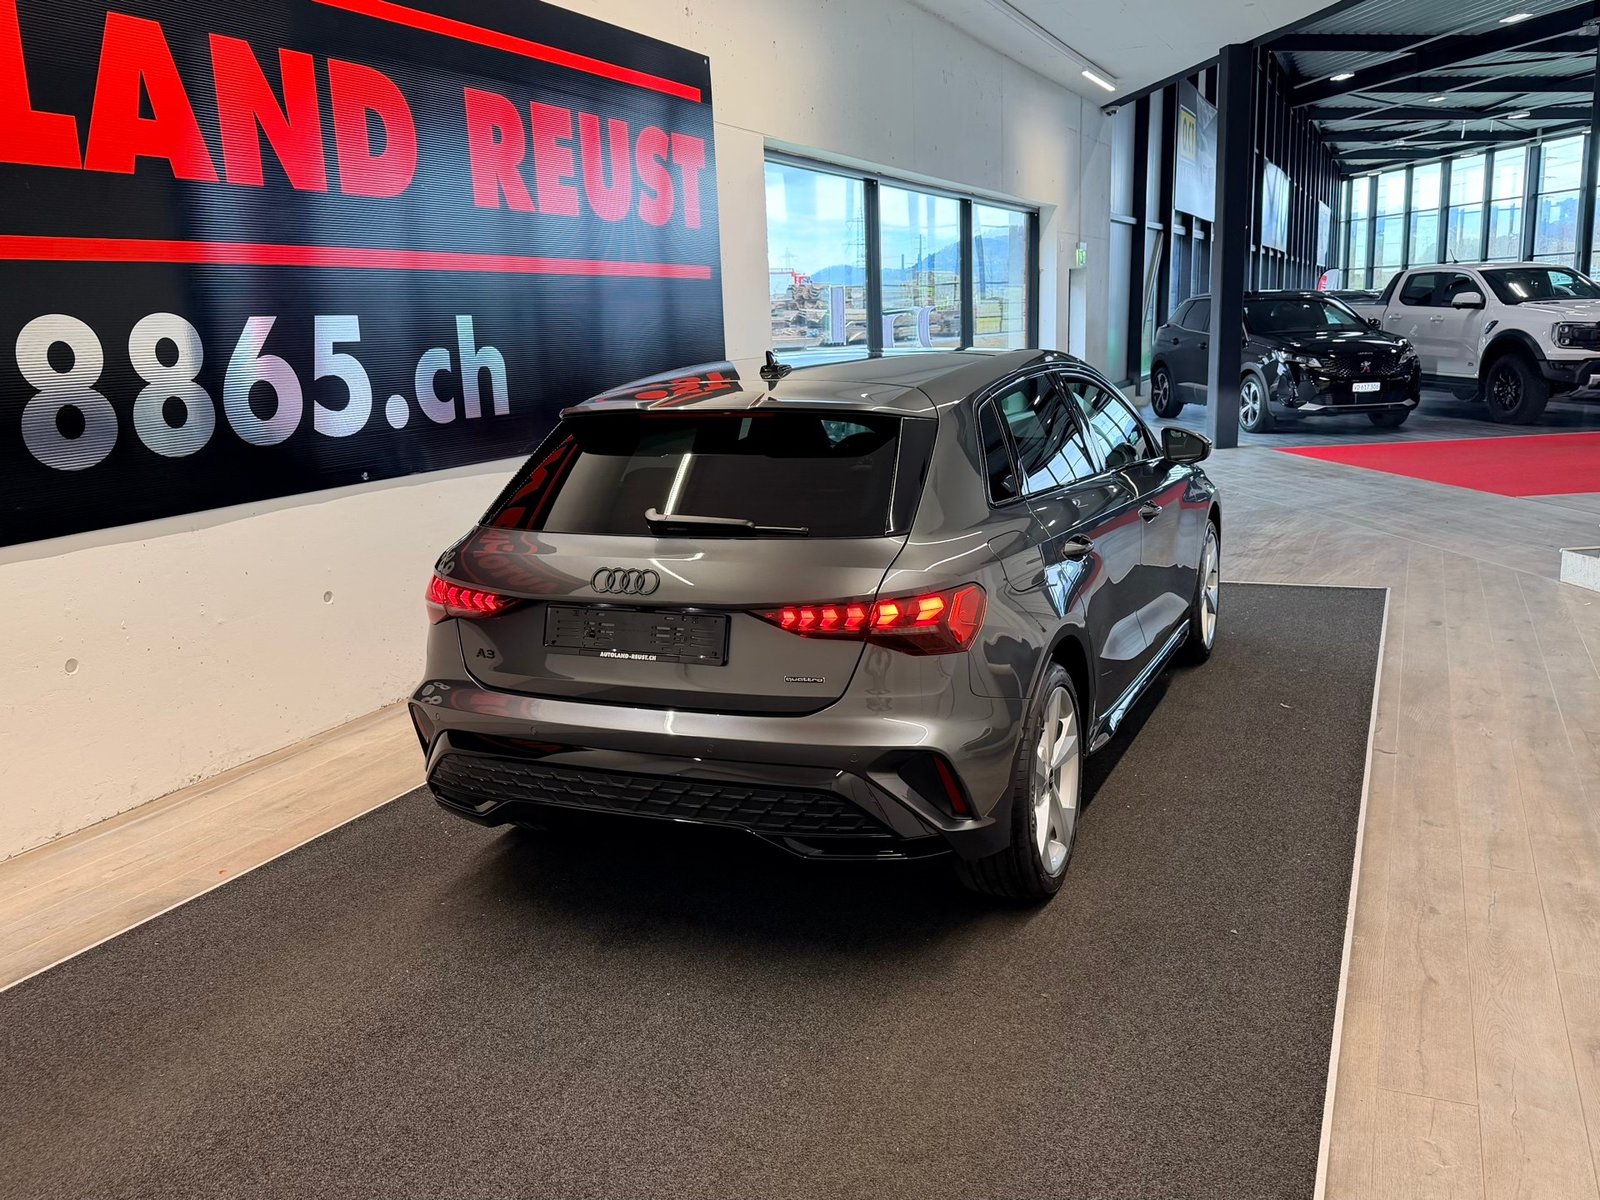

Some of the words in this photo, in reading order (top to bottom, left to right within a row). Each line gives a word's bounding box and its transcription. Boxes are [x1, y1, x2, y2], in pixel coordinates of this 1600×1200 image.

[464, 87, 706, 229] REUST
[15, 312, 510, 471] 8865.ch
[476, 648, 495, 659] A3
[599, 651, 657, 661] AUTOLAND-REUST.CH
